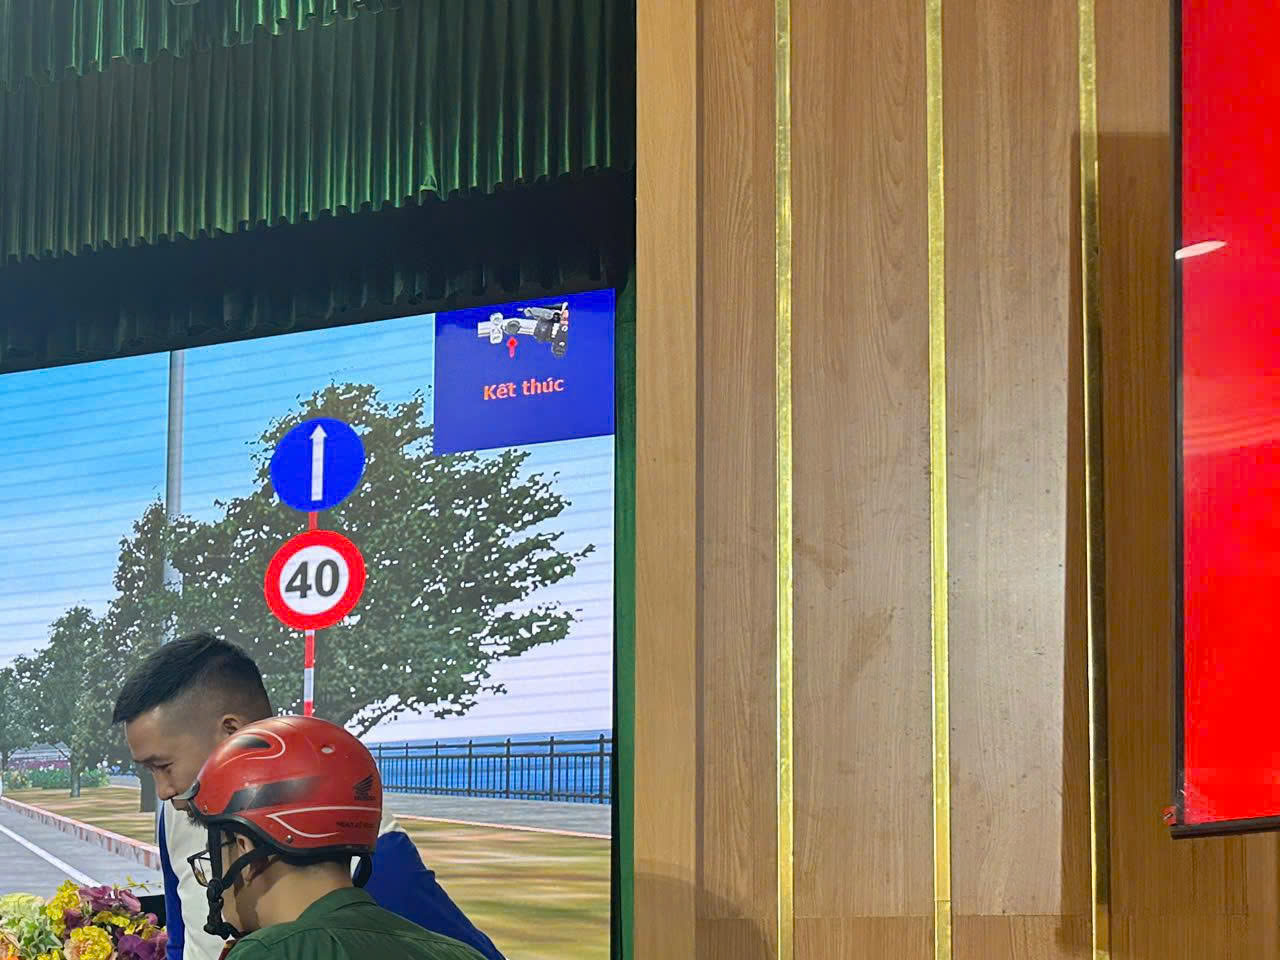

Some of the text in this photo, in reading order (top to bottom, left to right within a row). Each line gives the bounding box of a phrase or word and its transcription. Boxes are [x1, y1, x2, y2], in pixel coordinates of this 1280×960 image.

[483, 377, 564, 400] Kết thúc
[285, 559, 340, 599] 40
